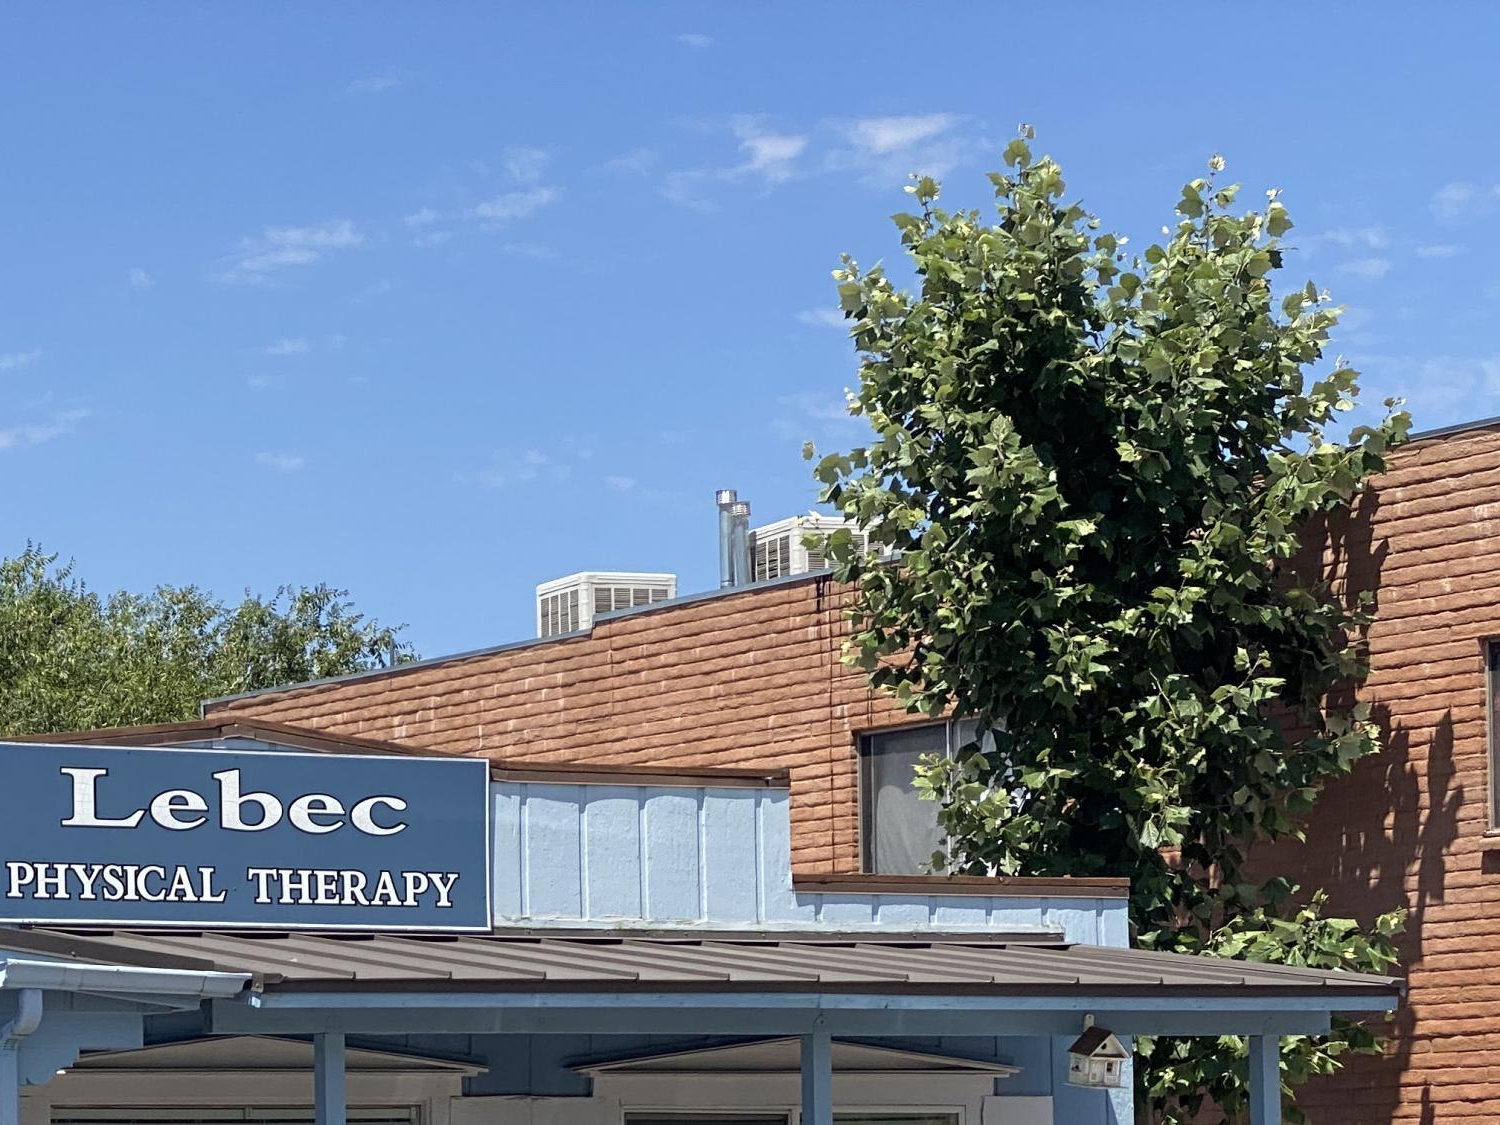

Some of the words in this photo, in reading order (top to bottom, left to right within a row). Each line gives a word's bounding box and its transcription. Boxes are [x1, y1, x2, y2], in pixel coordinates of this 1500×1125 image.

[60, 766, 408, 836] Lebec
[5, 861, 227, 903] PHYSICAL
[247, 867, 460, 908] THERAPY
